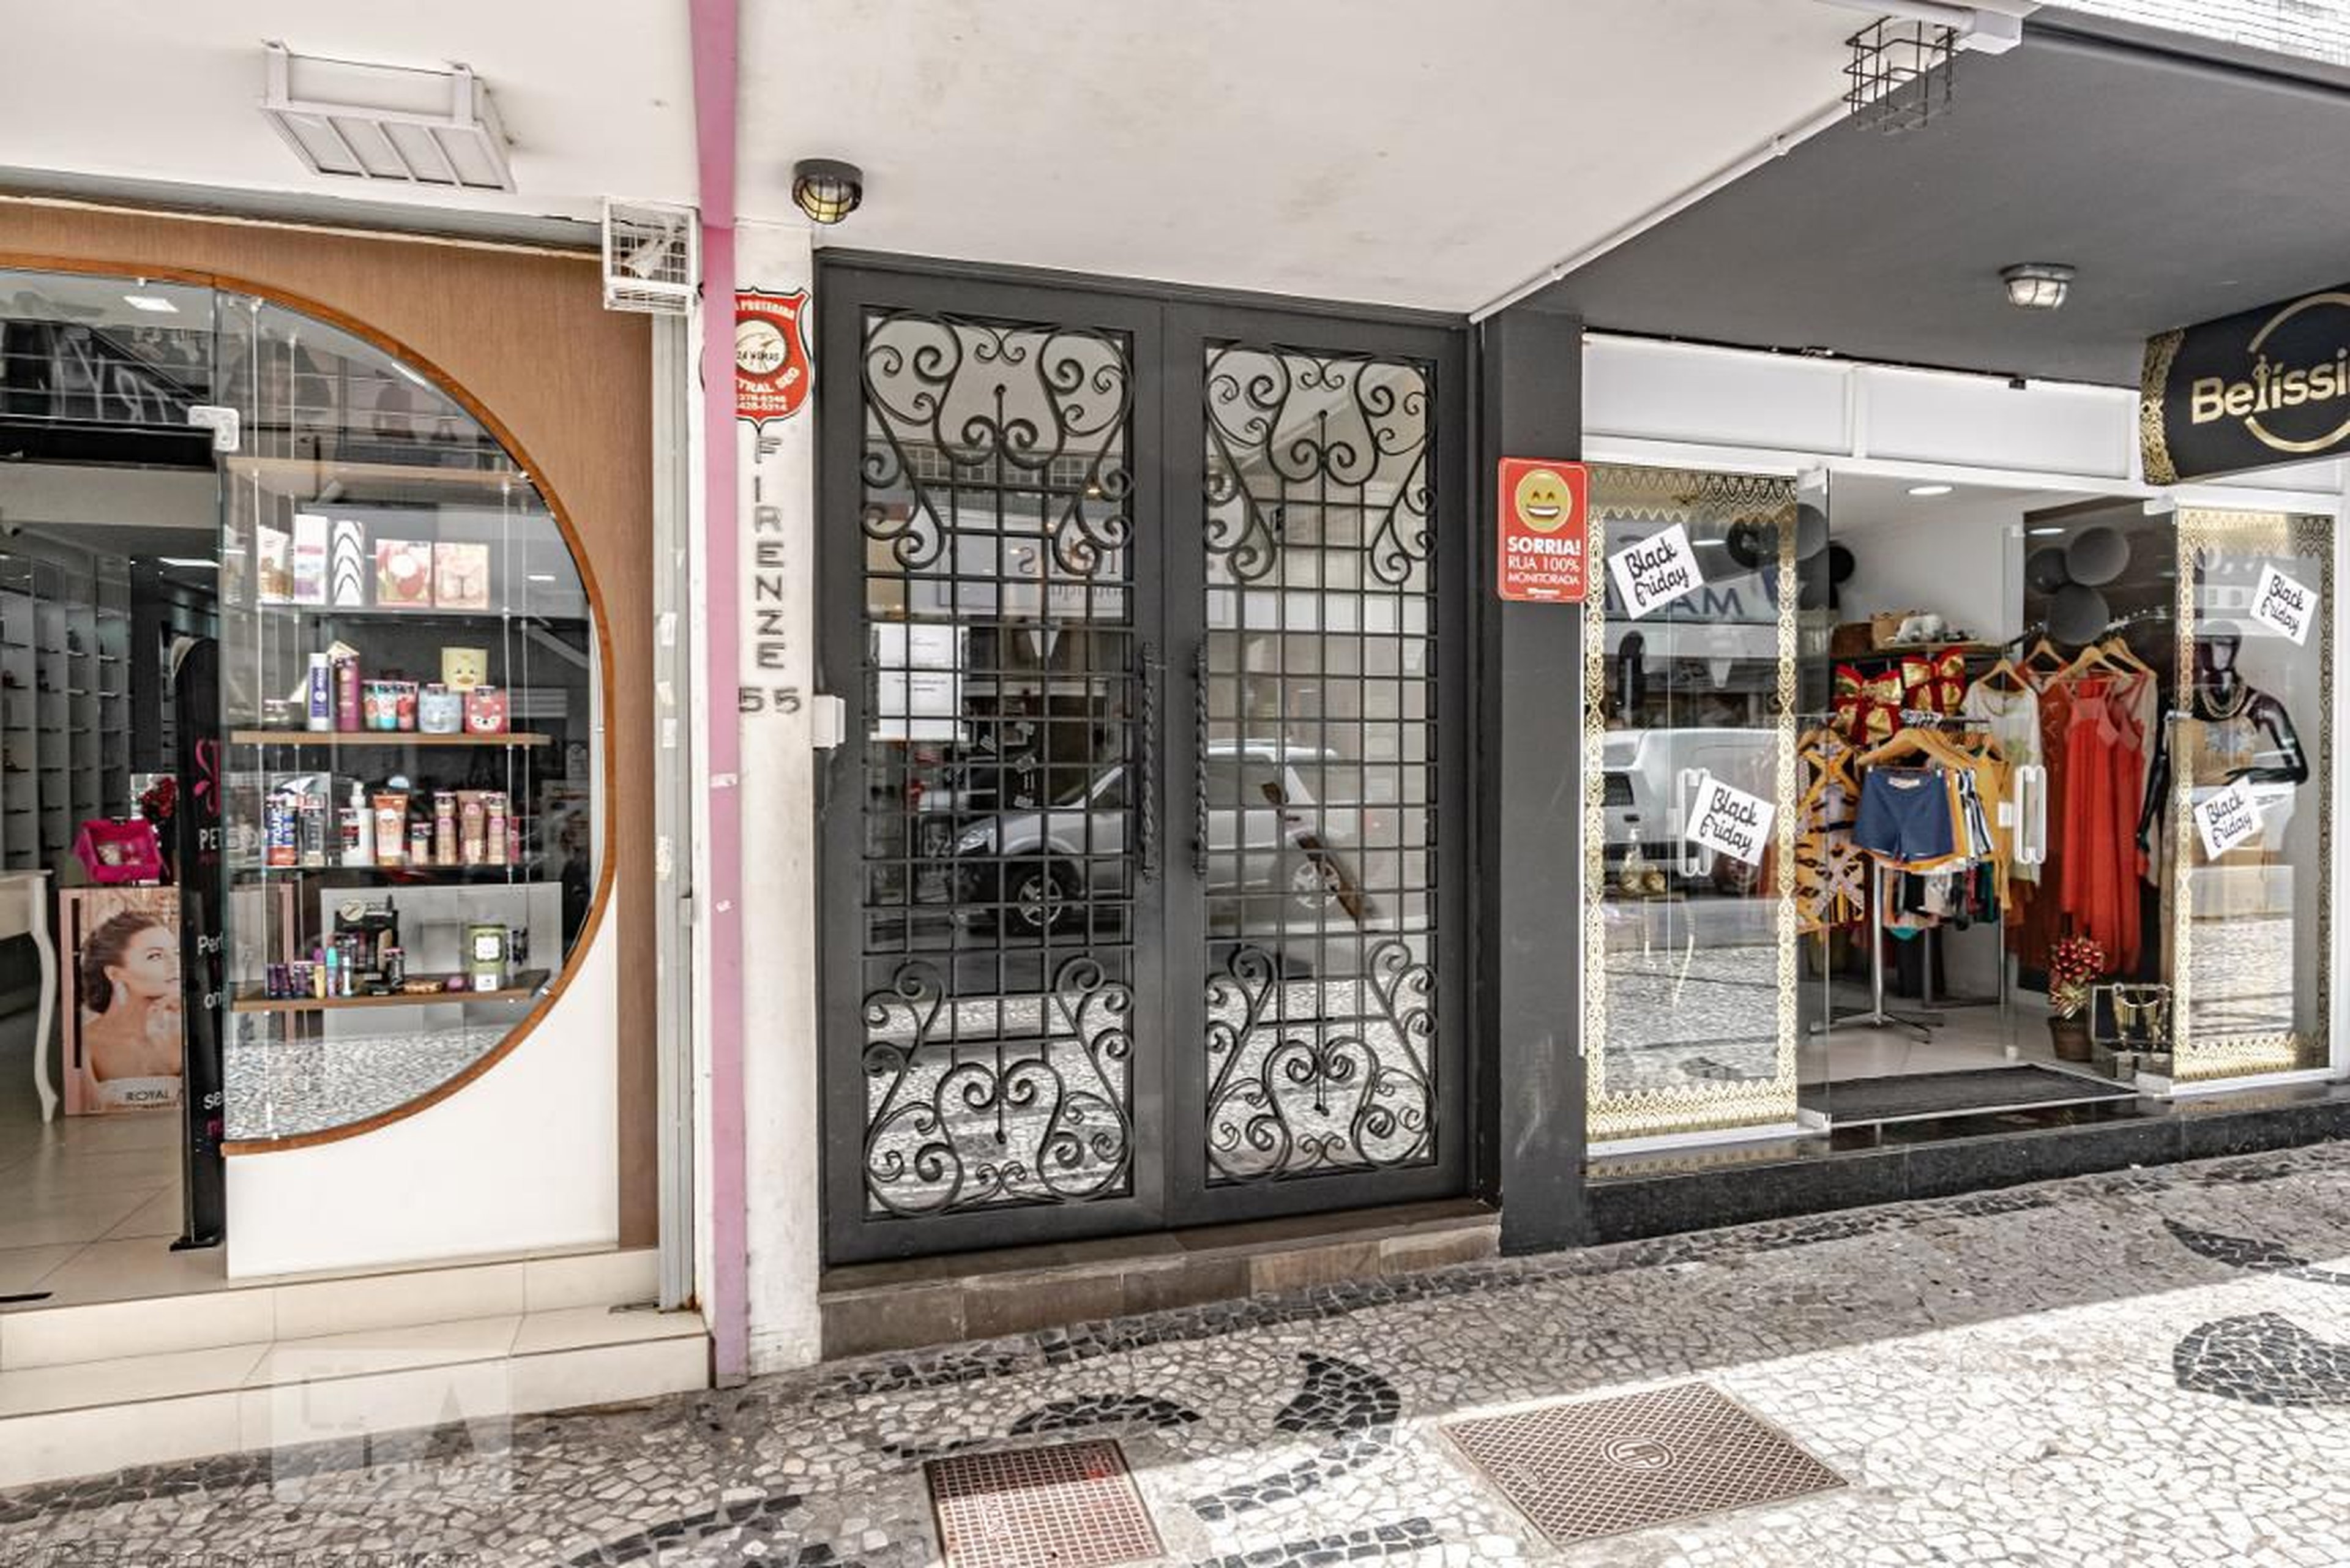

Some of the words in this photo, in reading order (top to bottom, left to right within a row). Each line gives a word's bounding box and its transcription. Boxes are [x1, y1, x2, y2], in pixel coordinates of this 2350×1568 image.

[754, 436, 786, 670] FIRENZE
[1507, 536, 1581, 555] SORRIA!
[1507, 555, 1537, 570] RUA
[1543, 557, 1580, 573] 100%
[1625, 537, 1677, 580] Black
[1634, 566, 1689, 606] Friday
[2269, 573, 2303, 611] Black
[2261, 596, 2299, 637] Friday
[738, 686, 802, 715] 55
[1710, 786, 1757, 826] Black
[2206, 790, 2244, 825] Black
[1700, 814, 1753, 857] Friday
[2212, 814, 2255, 848] Friday
[126, 1089, 168, 1101] ROYAL
